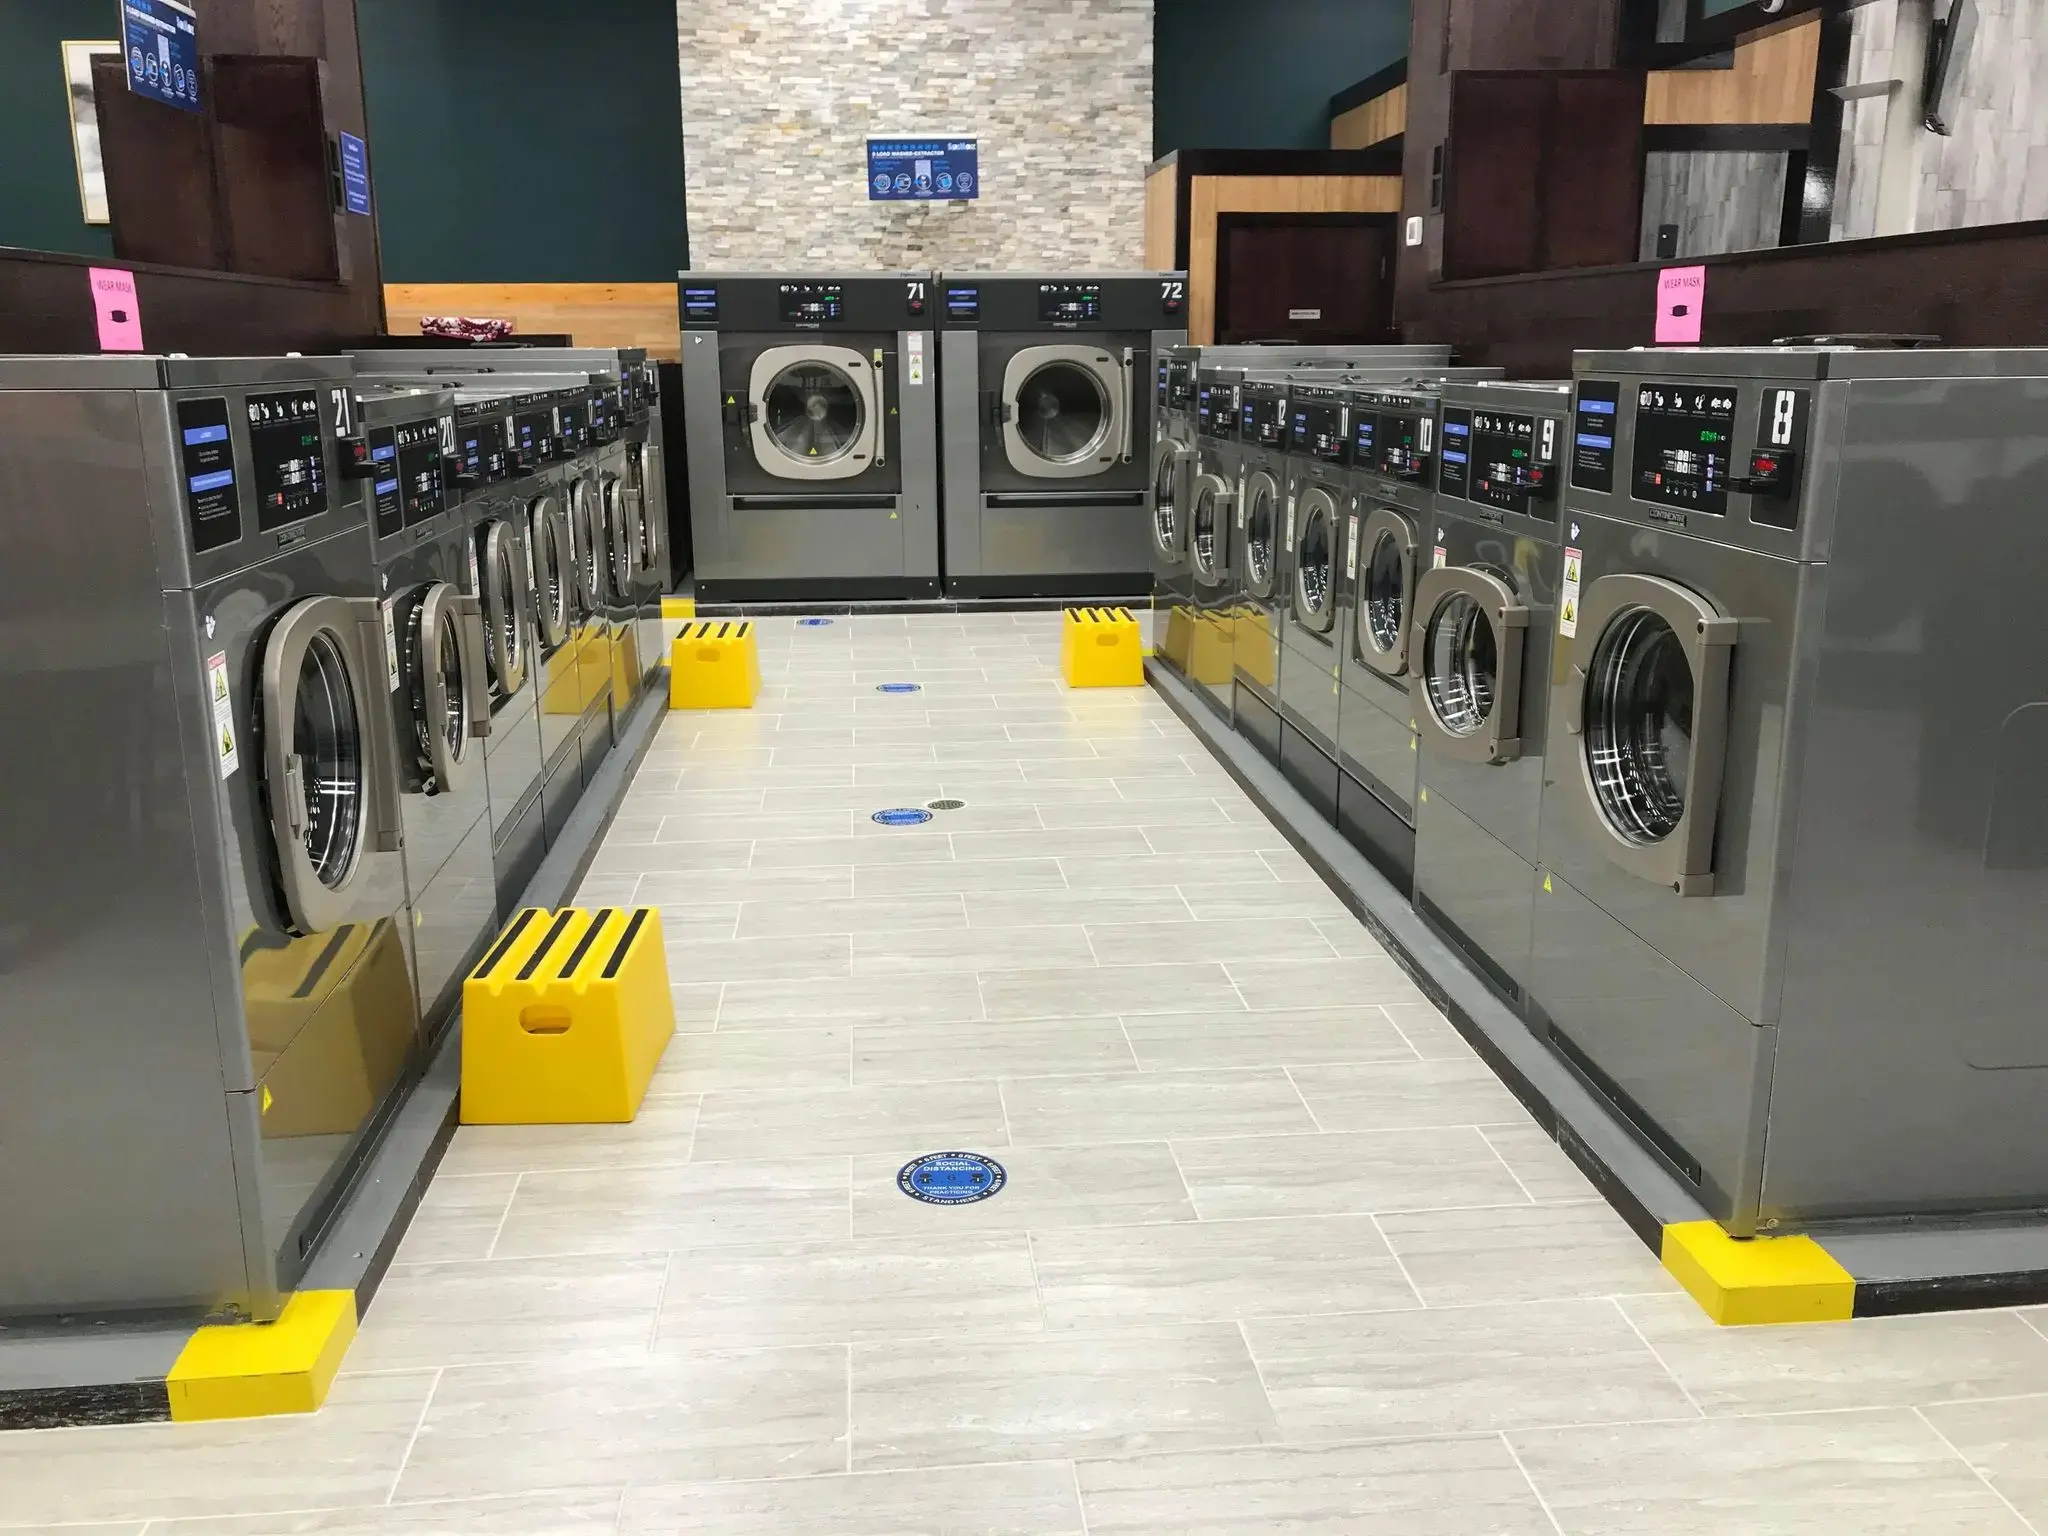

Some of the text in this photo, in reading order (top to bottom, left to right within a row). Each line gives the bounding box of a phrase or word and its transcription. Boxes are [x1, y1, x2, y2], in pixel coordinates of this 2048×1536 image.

[97, 279, 115, 291] WEAR
[907, 283, 924, 299] 71
[1161, 282, 1183, 299] 72
[1664, 277, 1701, 289] WEAR MASK
[331, 388, 351, 437] 21
[1278, 399, 1287, 426] 12
[1341, 406, 1349, 437] 11
[1771, 390, 1796, 445] 8
[440, 415, 455, 456] 20
[505, 415, 516, 449] 19
[1420, 417, 1433, 453] 10
[1541, 419, 1555, 460] 9
[921, 1195, 982, 1204] STAND HERE
